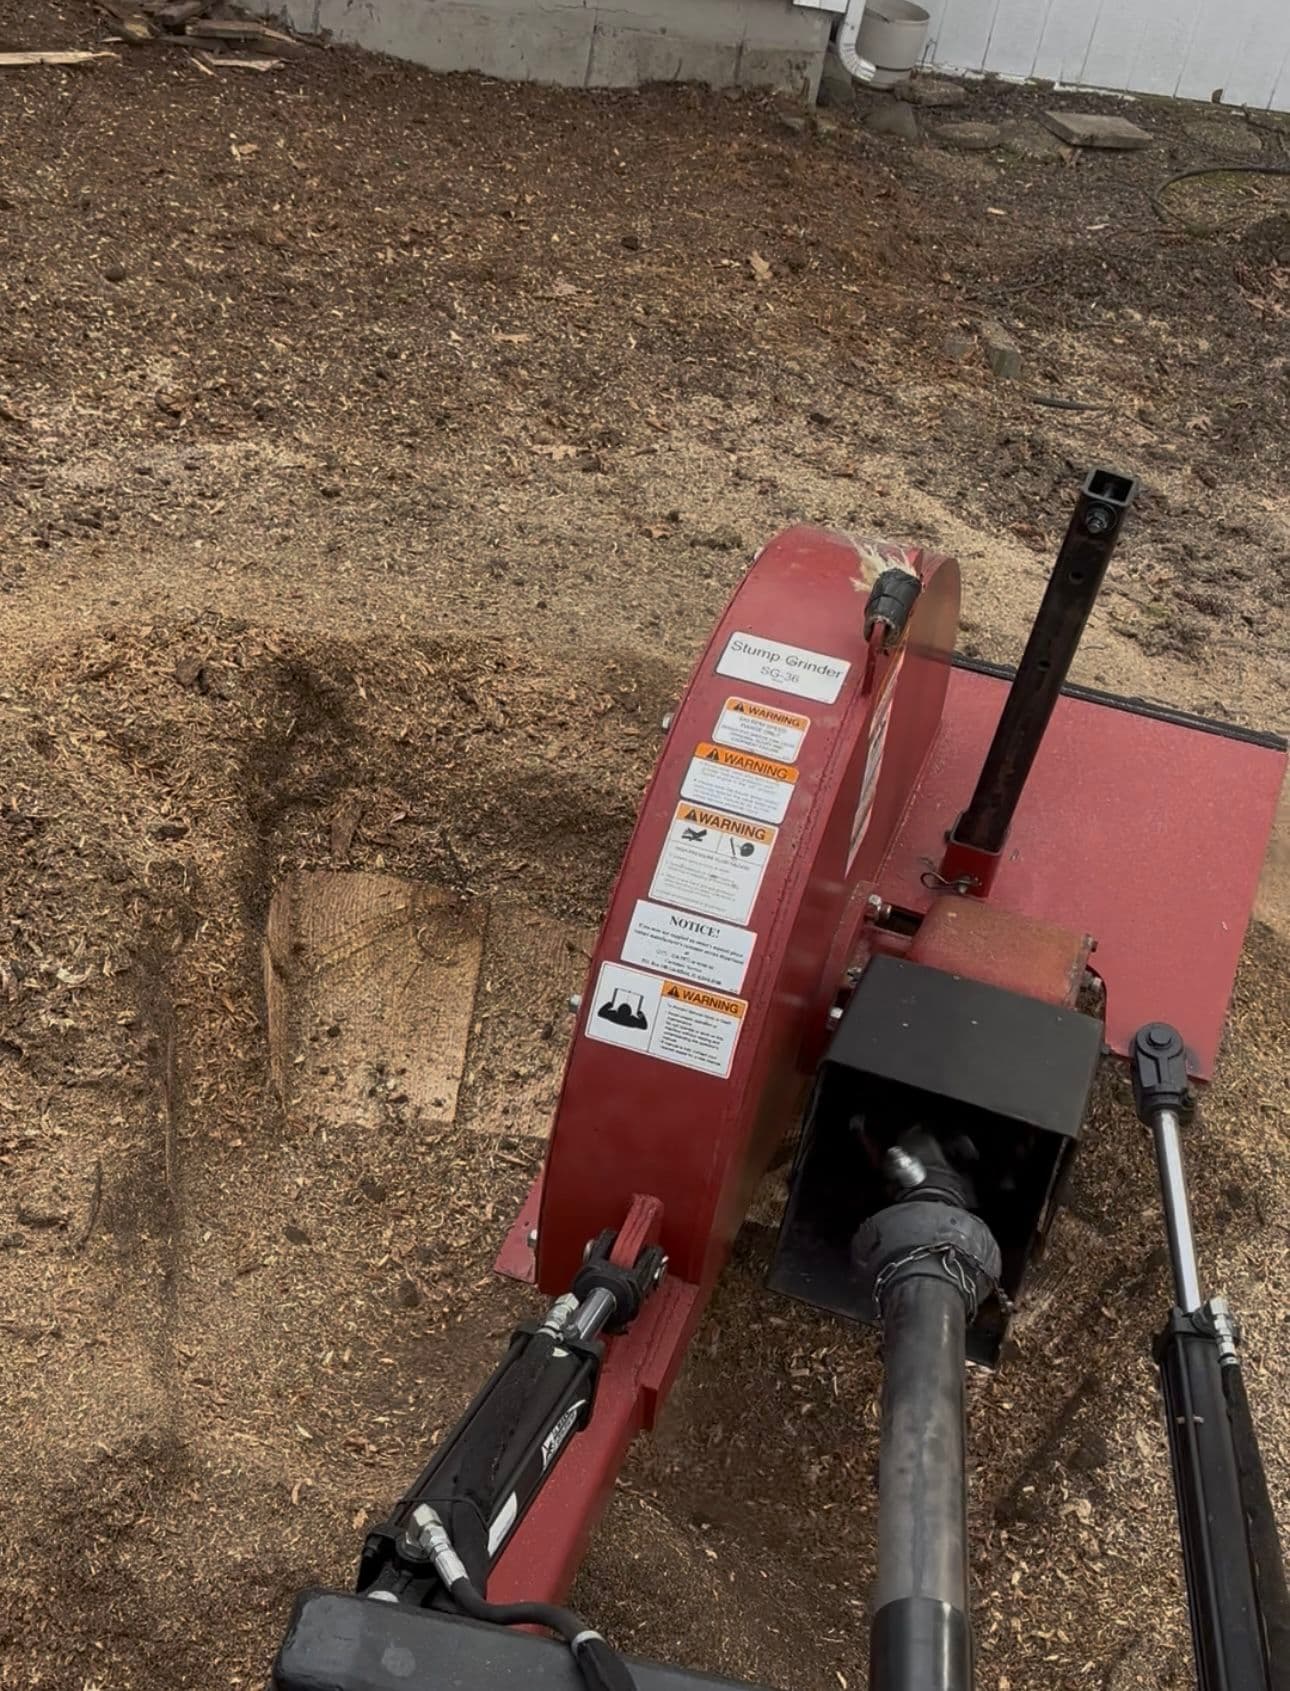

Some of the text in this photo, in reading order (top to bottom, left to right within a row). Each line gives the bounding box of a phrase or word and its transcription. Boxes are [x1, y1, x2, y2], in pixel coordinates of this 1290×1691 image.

[731, 640, 844, 678] Stump Grinder
[760, 666, 799, 683] SG-36
[749, 705, 800, 727] WARNING
[725, 752, 788, 778] WARNING
[700, 811, 766, 840] WARNING
[669, 915, 720, 938] NOTICE!
[683, 990, 738, 1013] WARNING
